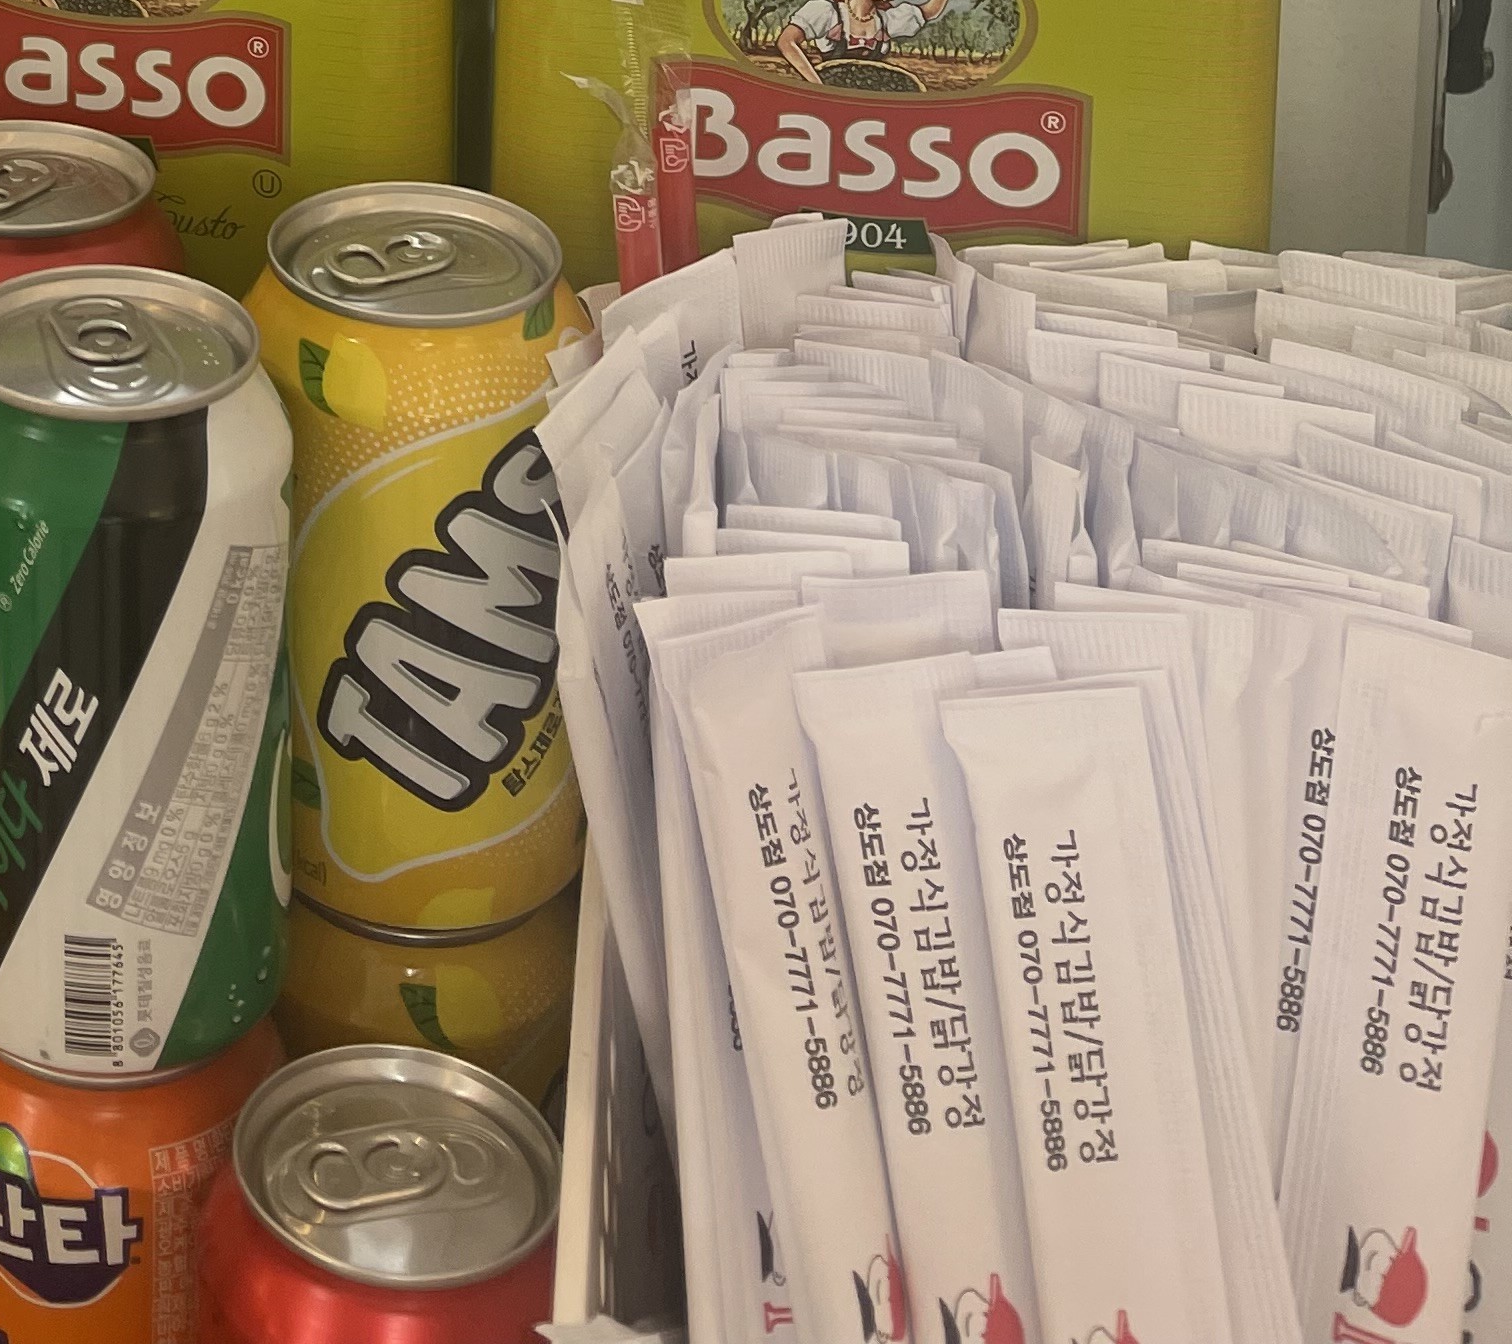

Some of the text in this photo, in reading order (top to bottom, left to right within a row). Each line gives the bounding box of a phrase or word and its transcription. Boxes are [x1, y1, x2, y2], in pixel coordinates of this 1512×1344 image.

[676, 86, 1061, 209] Basso
[9, 519, 50, 596] Zero Calorie
[18, 666, 100, 788] 제로
[1275, 726, 1337, 1034] 상도점 070-7771-5886
[748, 782, 838, 1111] 상도점 070-7771-5886
[852, 801, 933, 1137] 상도점 070-7771-5886
[900, 795, 987, 1130] 가정식김밥/닭강정
[1002, 832, 1069, 1173] 상도점 070-7771-5886
[1043, 828, 1120, 1166] 가정식김밥/닭강정
[1360, 765, 1424, 1077] 상도점 070-7771-5886
[1398, 782, 1480, 1094] 가정식김밥/닭강정
